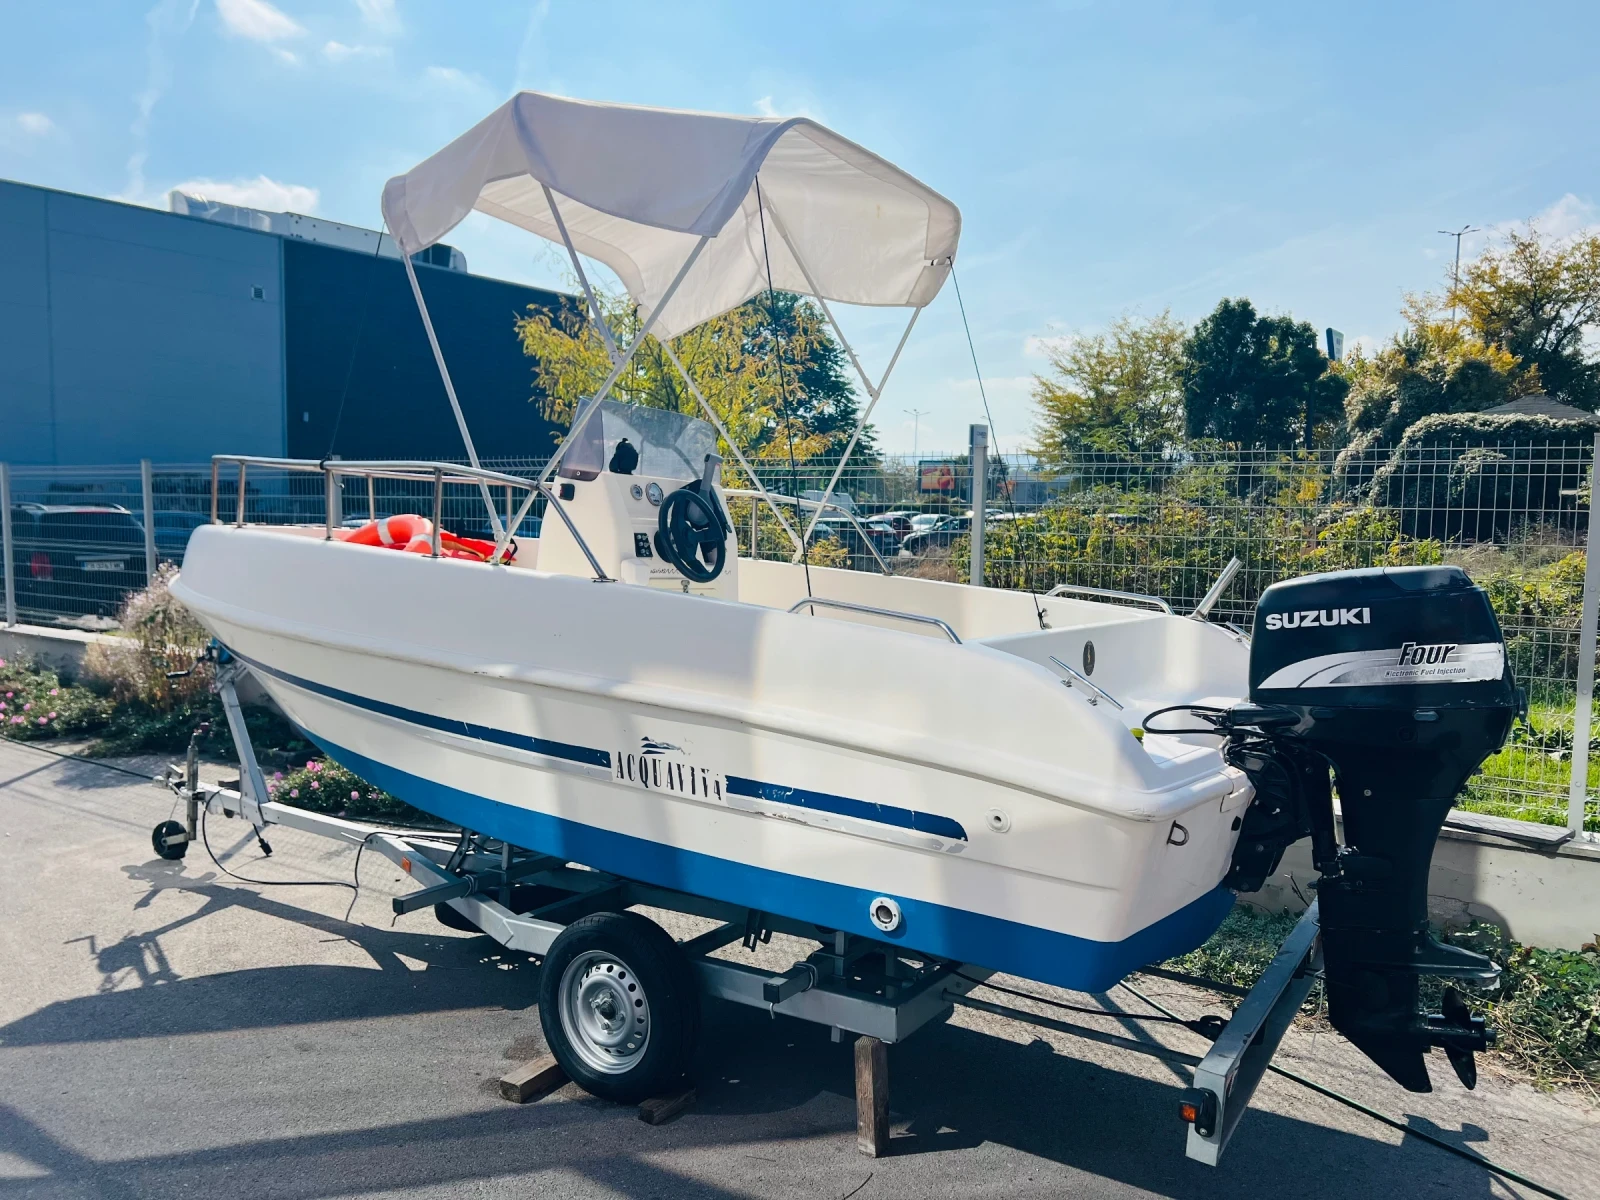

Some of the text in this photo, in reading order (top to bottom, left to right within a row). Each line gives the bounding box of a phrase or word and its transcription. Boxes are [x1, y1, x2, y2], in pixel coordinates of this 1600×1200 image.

[1265, 607, 1371, 630] SUZUKI
[1398, 642, 1457, 666] Four
[1420, 668, 1436, 676] Fuel
[1437, 667, 1467, 676] Injection
[616, 751, 722, 801] ACQUAVIVA
